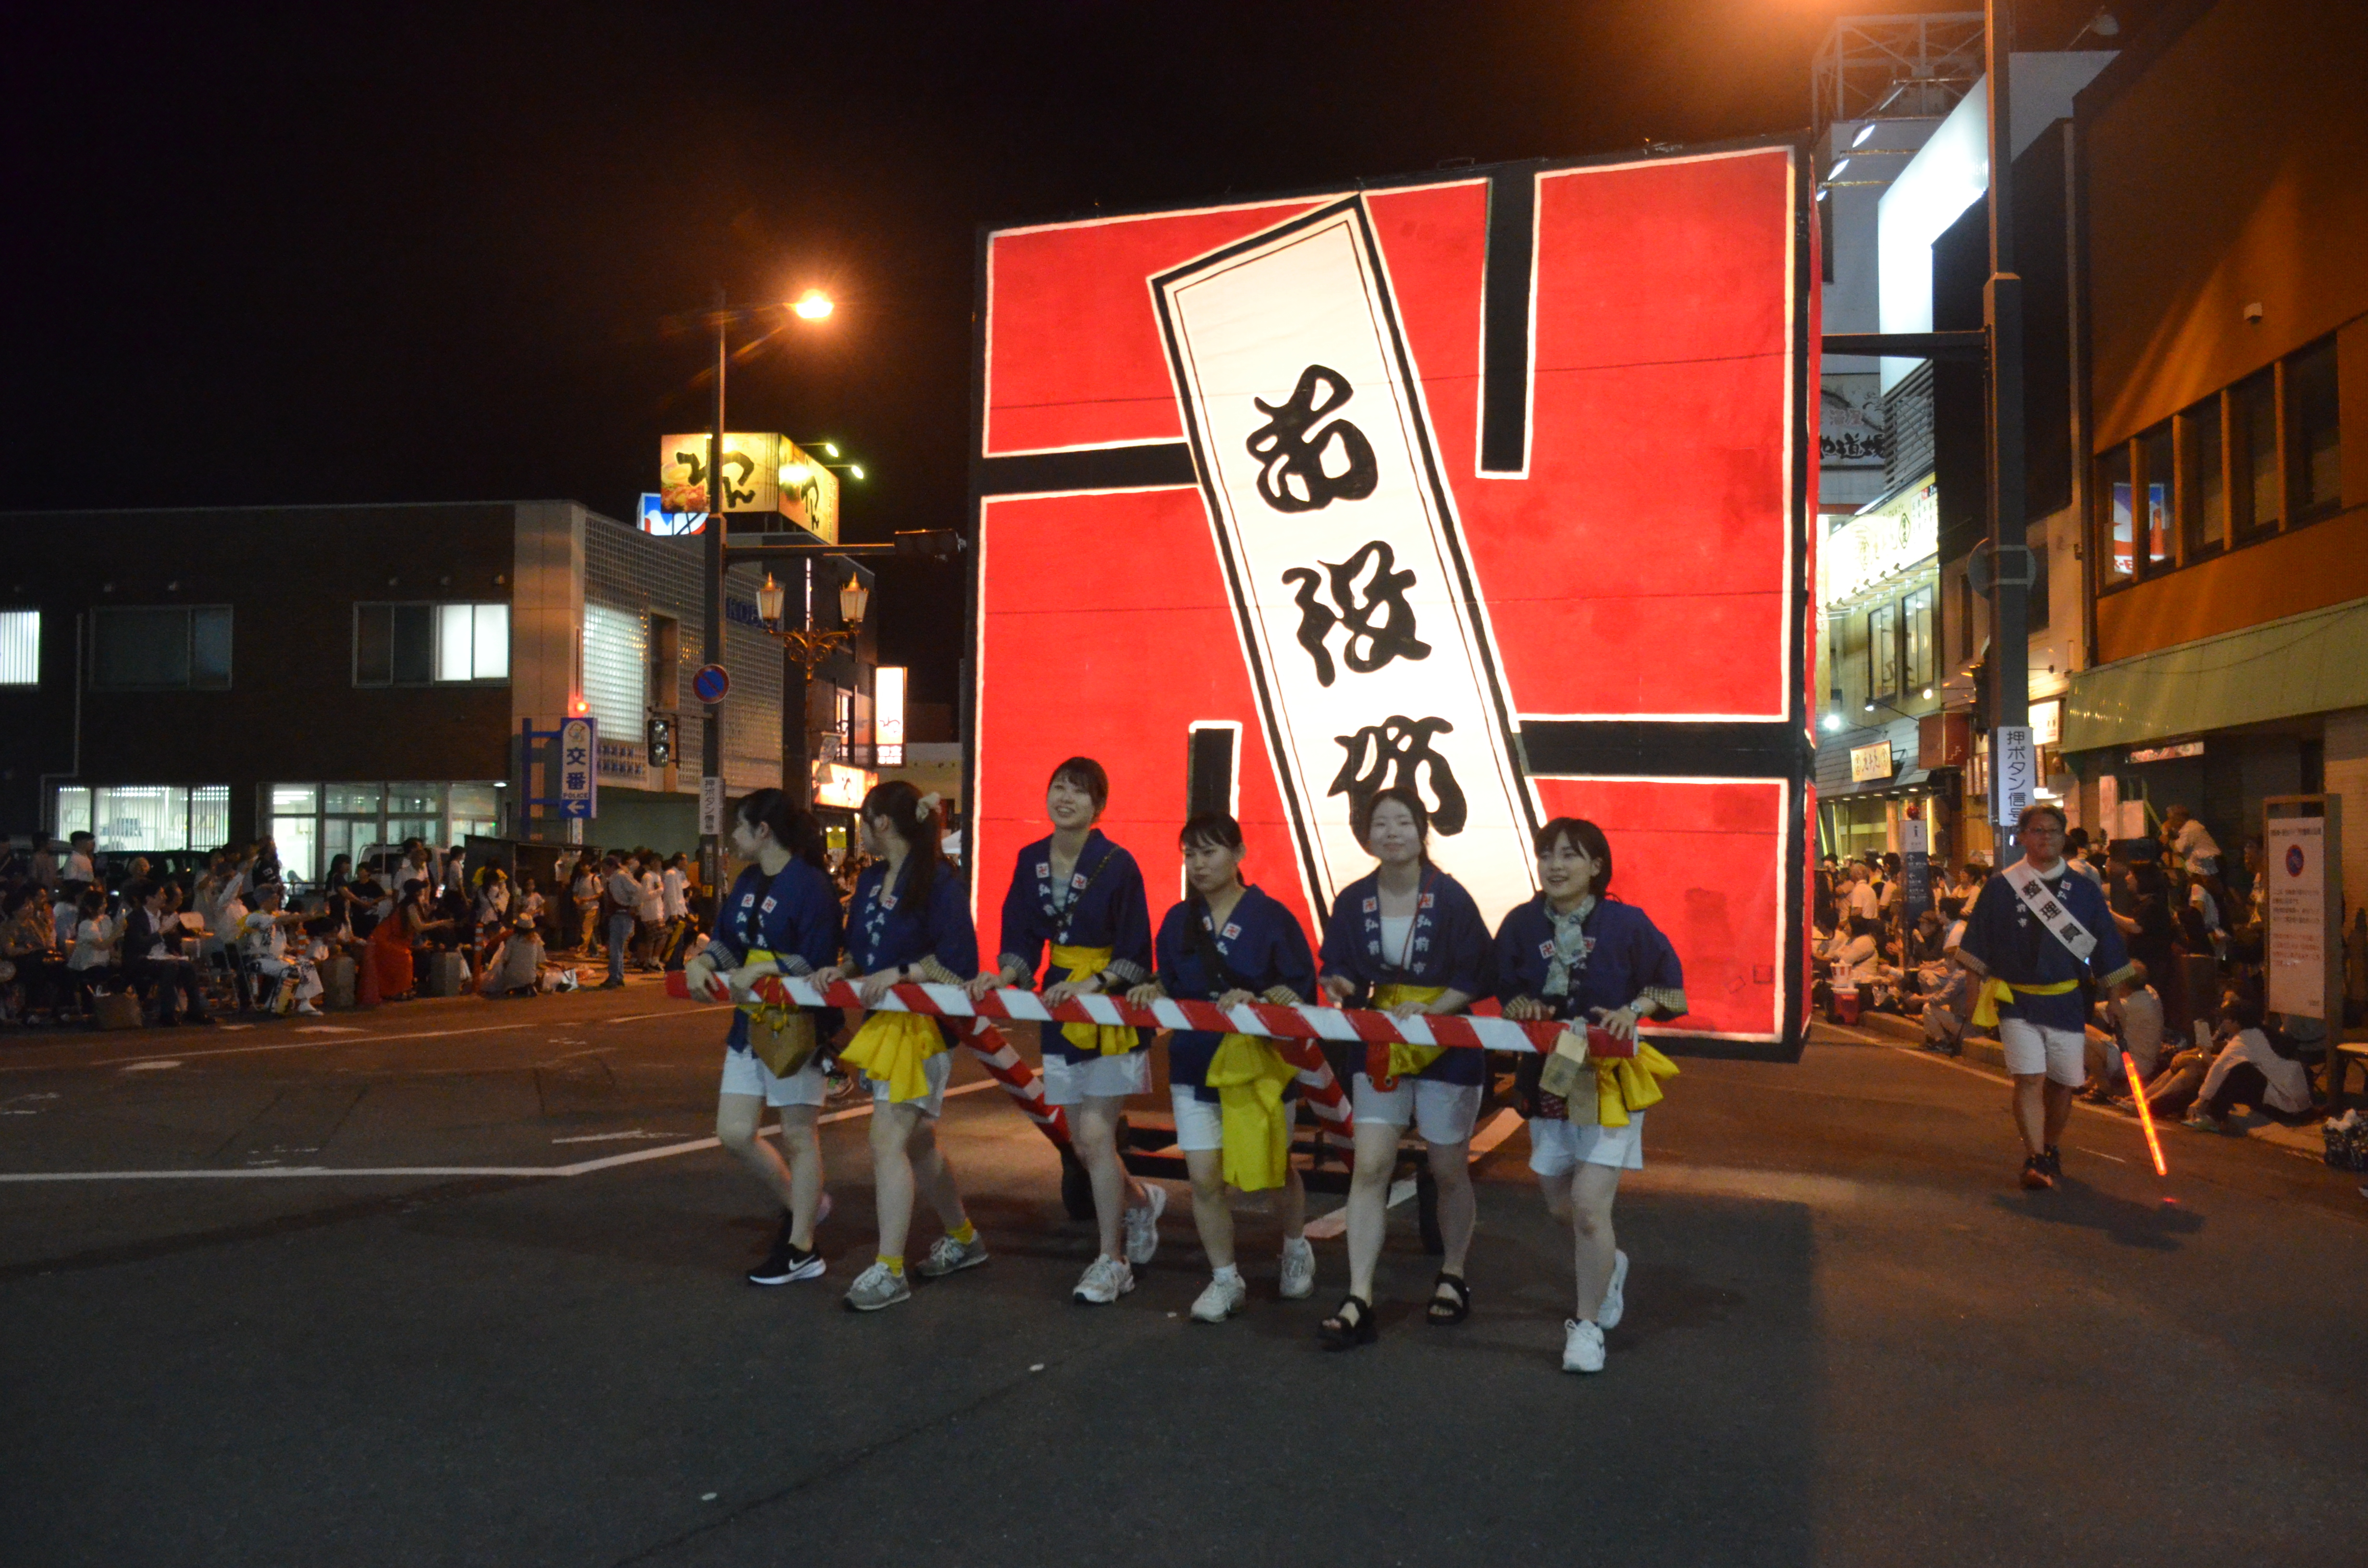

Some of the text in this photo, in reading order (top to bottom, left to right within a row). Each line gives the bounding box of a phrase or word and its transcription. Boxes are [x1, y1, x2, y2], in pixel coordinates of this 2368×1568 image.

[567, 747, 586, 790] 交番
[2007, 731, 2026, 822] 押ボタン信号
